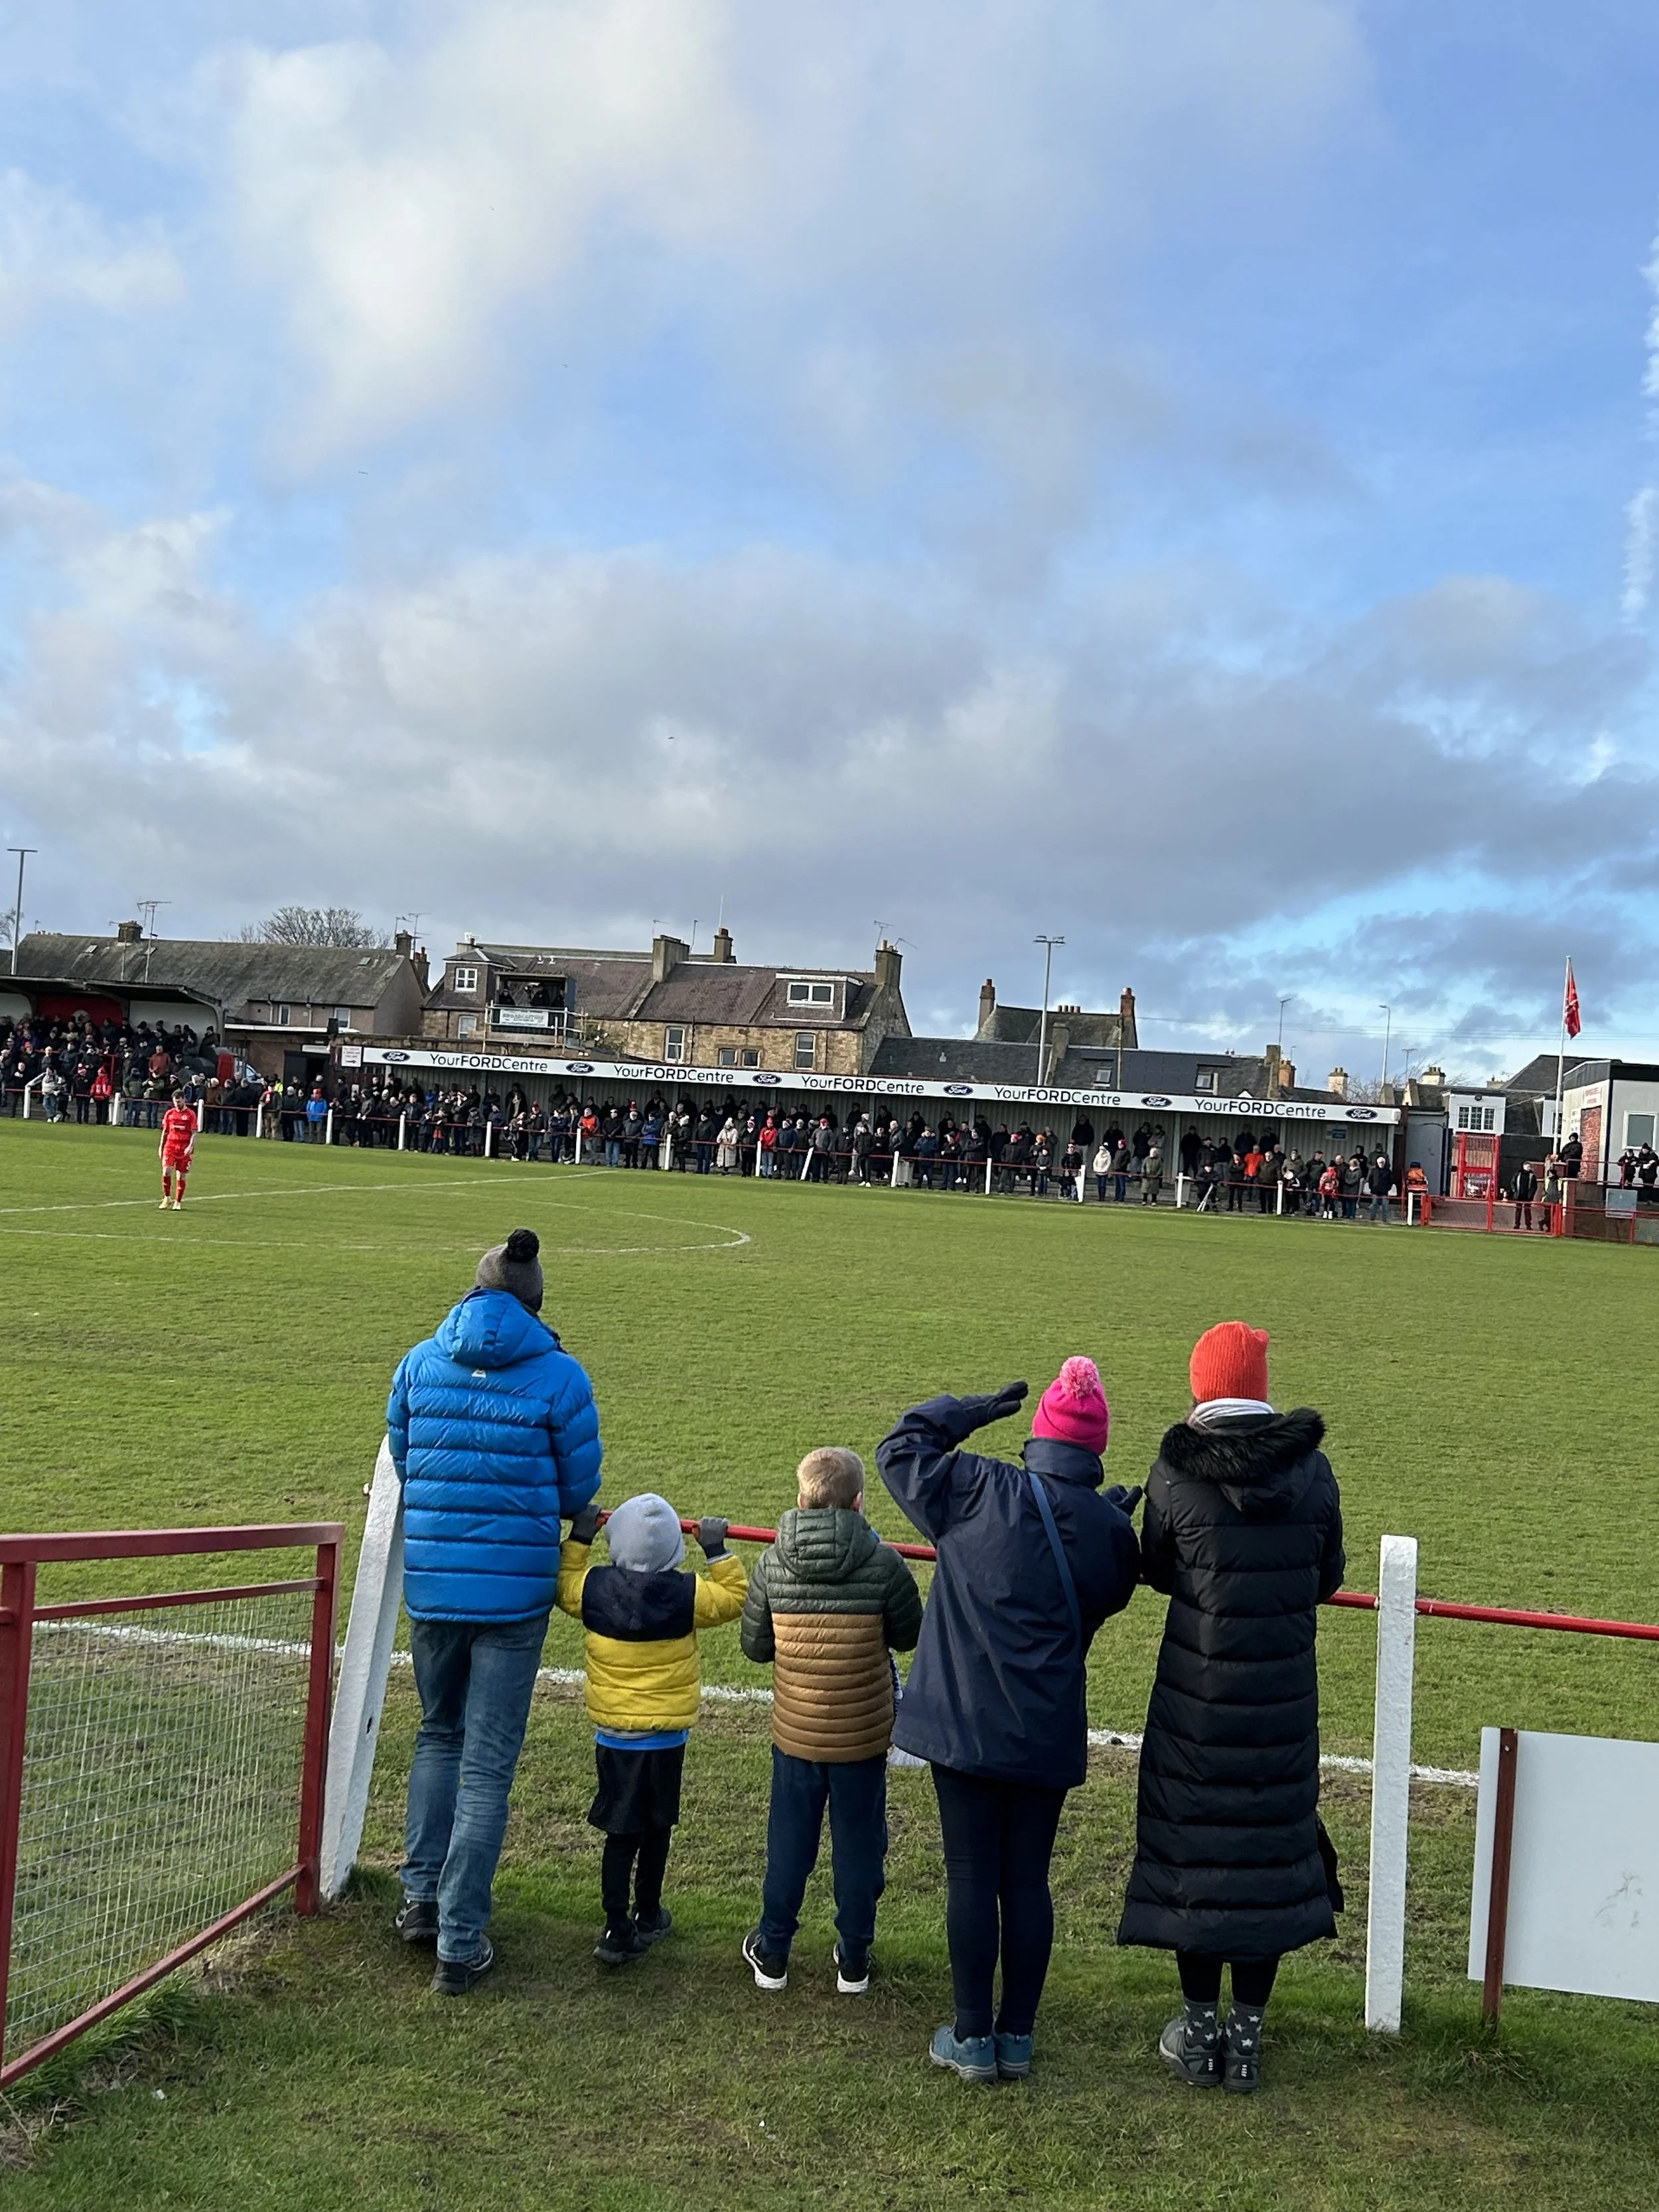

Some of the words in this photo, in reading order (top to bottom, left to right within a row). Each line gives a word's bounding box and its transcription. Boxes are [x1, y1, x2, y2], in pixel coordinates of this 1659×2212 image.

[430, 1054, 548, 1072] YourFORDCentre
[614, 1065, 734, 1083] YourFORDCentre
[801, 1076, 924, 1094] YourFORDCentre
[994, 1087, 1121, 1105] YourFORDCentre
[1194, 1099, 1326, 1118] YourFORDCentre
